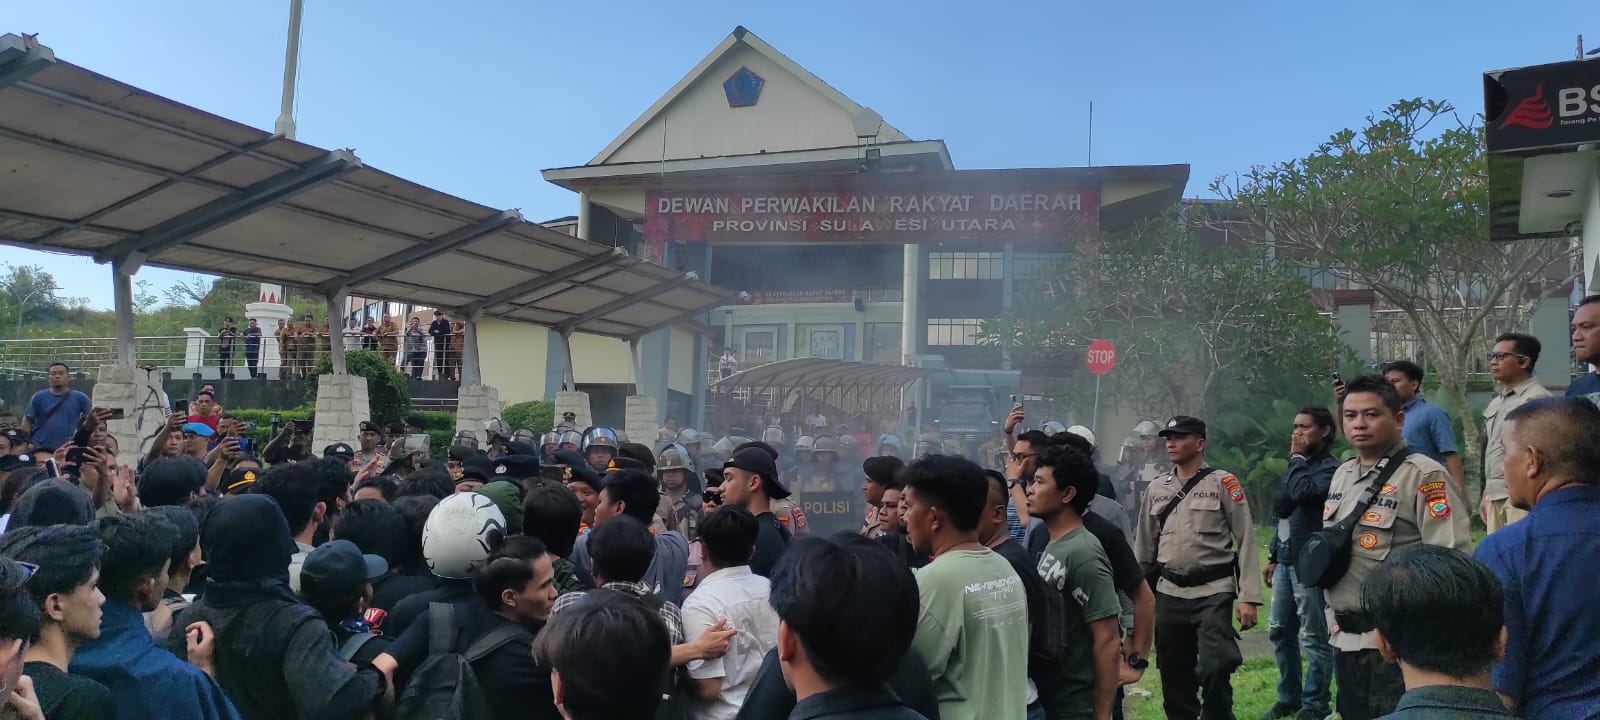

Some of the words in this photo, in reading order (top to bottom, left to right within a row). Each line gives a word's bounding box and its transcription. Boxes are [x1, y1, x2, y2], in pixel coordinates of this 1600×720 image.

[658, 197, 729, 214] DEWAN
[741, 196, 875, 214] PERWAKILAN
[890, 195, 974, 213] RAKYAT
[990, 193, 1081, 211] DAERAH
[712, 220, 807, 232] PROVINSI
[941, 218, 1016, 231] UTARA
[1087, 350, 1114, 364] STOP
[1193, 491, 1219, 499] POLRI
[804, 500, 850, 514] POLISI
